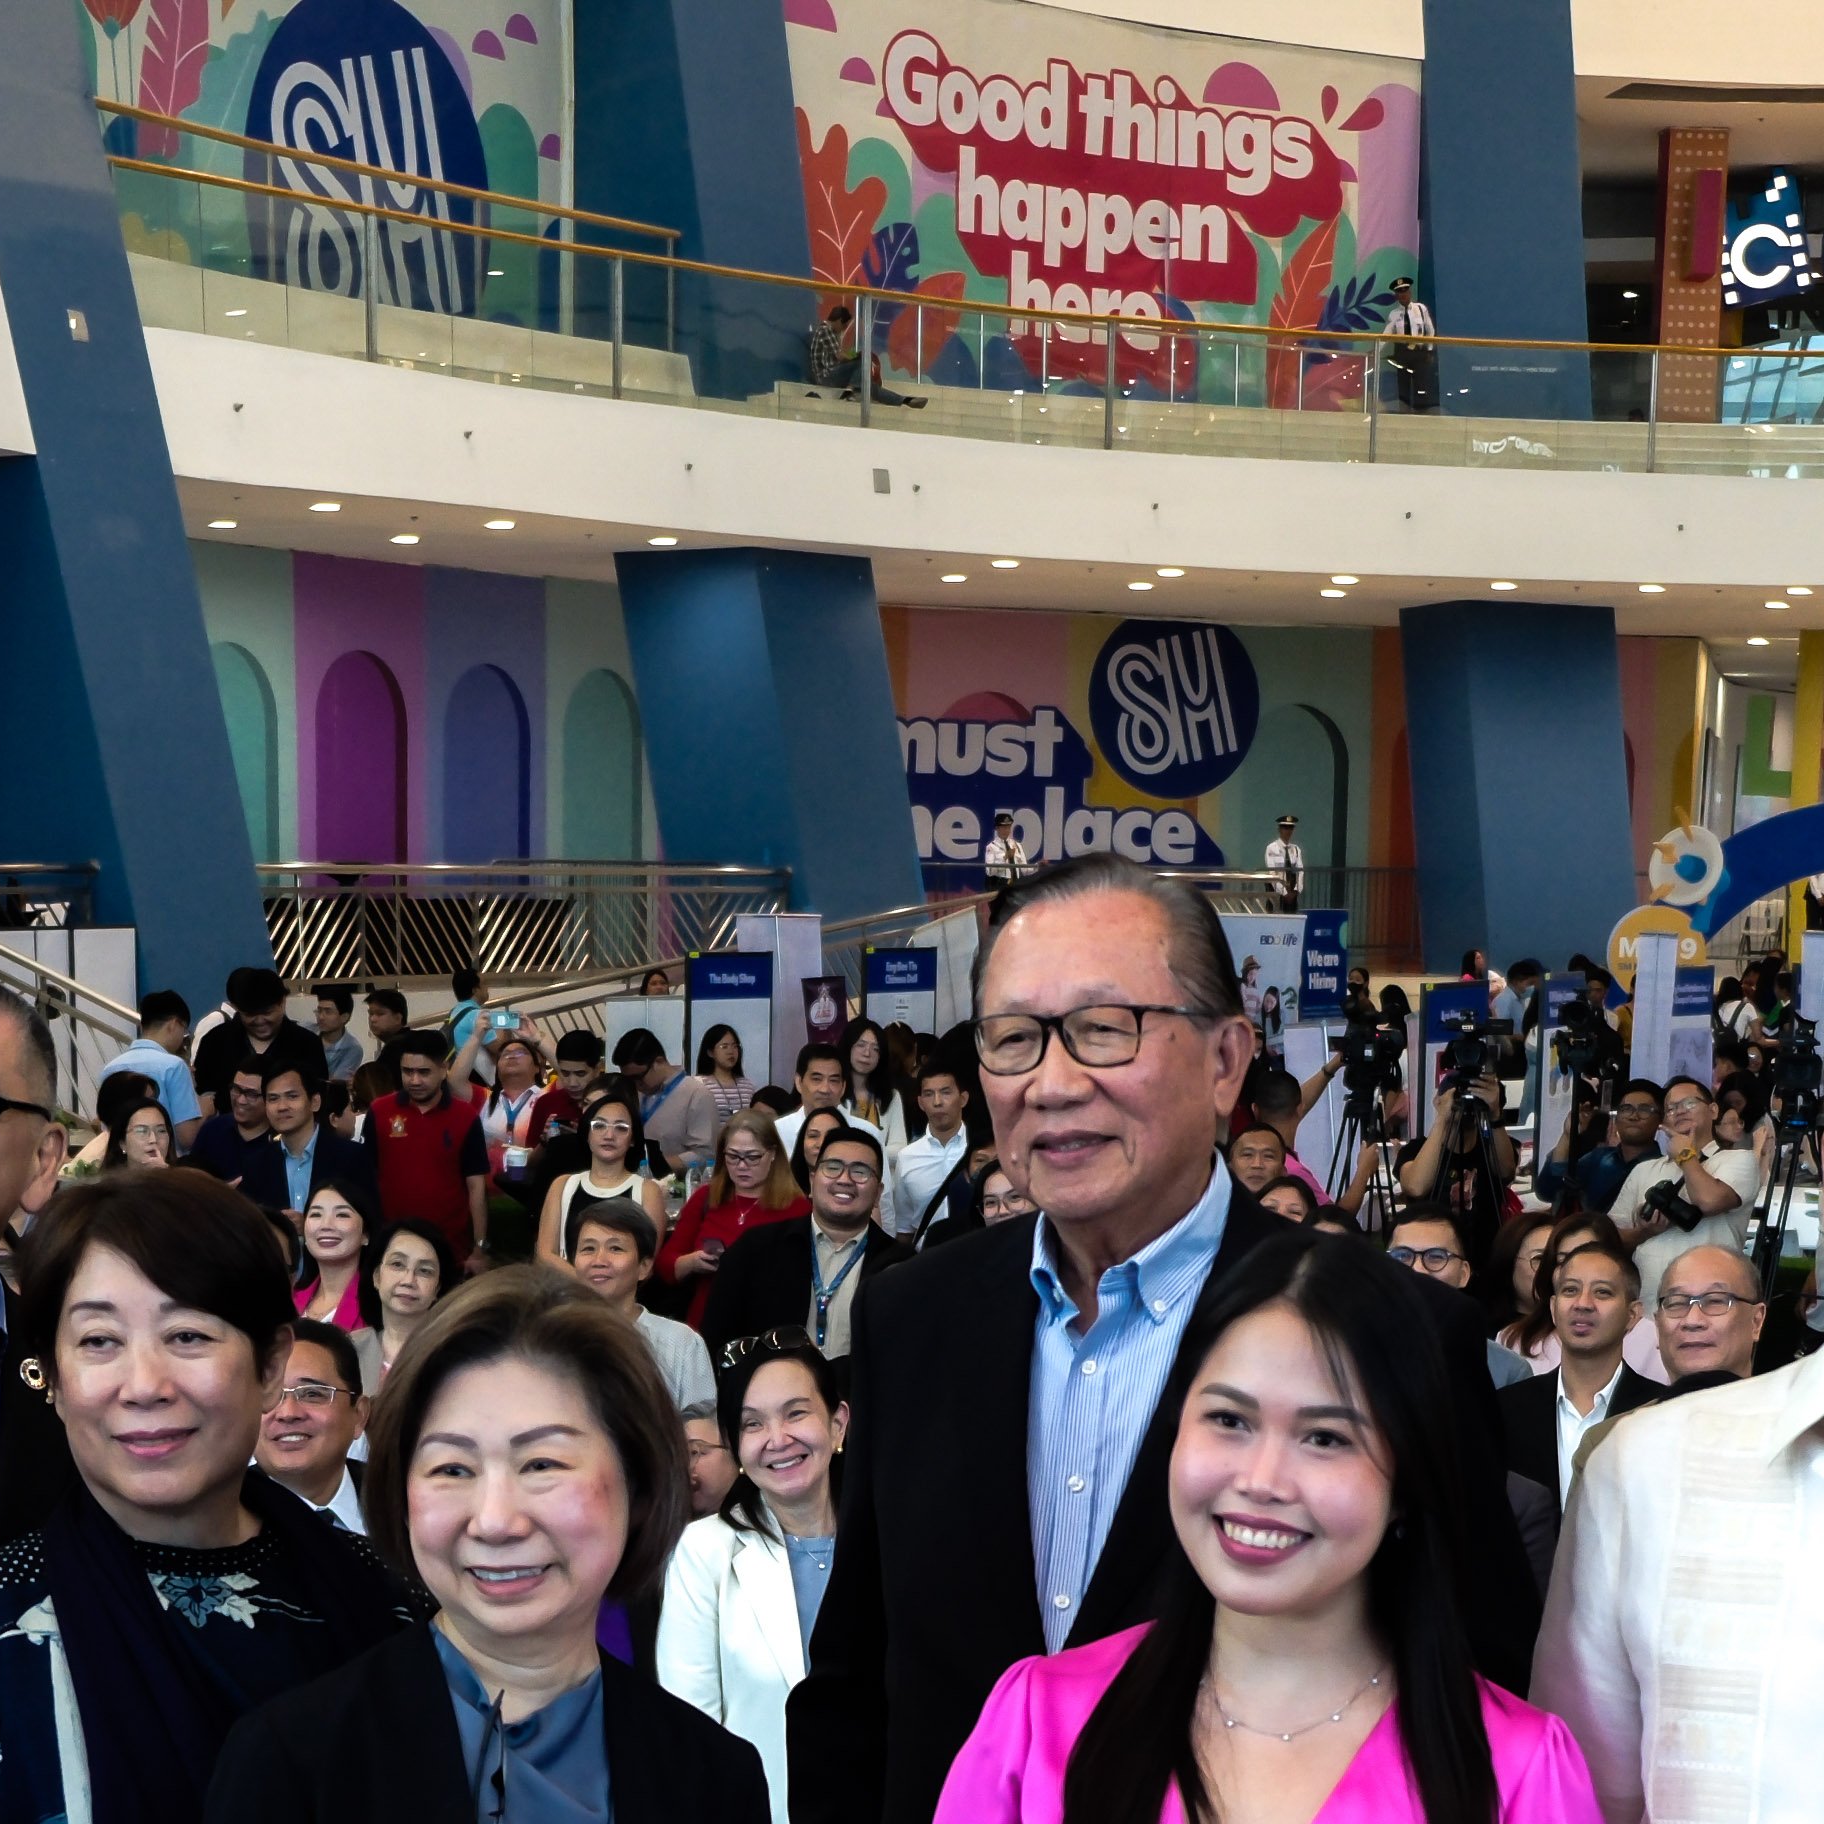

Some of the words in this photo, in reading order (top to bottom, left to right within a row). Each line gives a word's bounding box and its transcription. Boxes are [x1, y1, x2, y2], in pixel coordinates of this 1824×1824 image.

[884, 34, 1069, 149] Good
[1079, 69, 1314, 196] things
[957, 146, 1228, 272] happen
[1011, 250, 1162, 350] here
[1106, 628, 1238, 775] SM
[1307, 950, 1323, 967] We
[1324, 954, 1339, 967] are
[1309, 972, 1337, 993] Hiring
